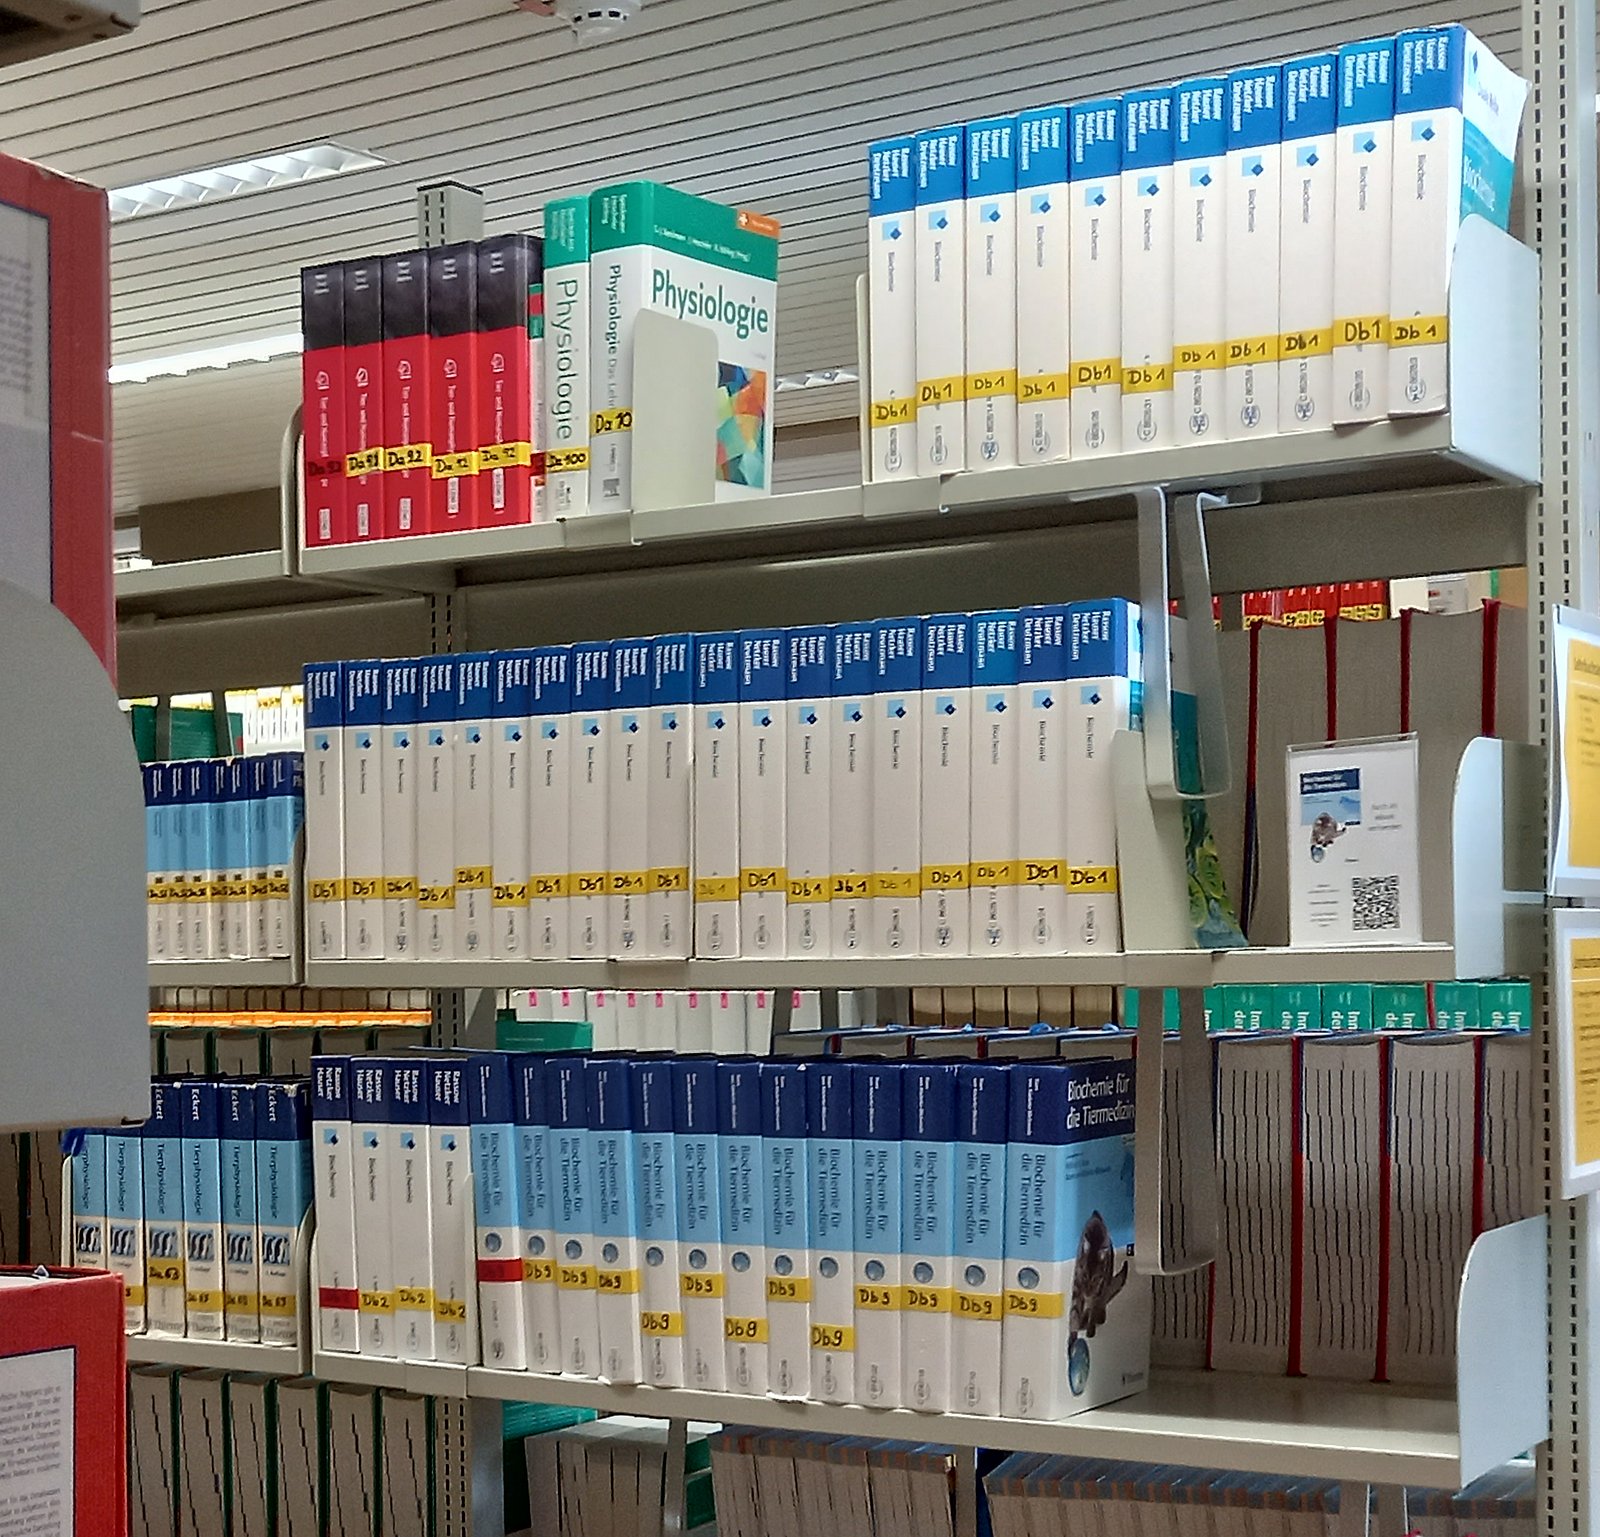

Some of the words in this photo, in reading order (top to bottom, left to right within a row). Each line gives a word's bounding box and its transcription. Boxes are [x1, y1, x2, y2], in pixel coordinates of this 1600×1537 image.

[605, 264, 621, 356] Physiologie
[652, 268, 769, 340] Physiologie
[550, 279, 579, 440] Physiologie
[1067, 1076, 1113, 1102] Biochemie
[1115, 1072, 1130, 1096] für
[155, 1089, 163, 1120] Eckert
[191, 1088, 199, 1121] Eckert
[231, 1089, 239, 1122] Eckert
[269, 1089, 277, 1122] Eckert
[1066, 1108, 1081, 1130] die
